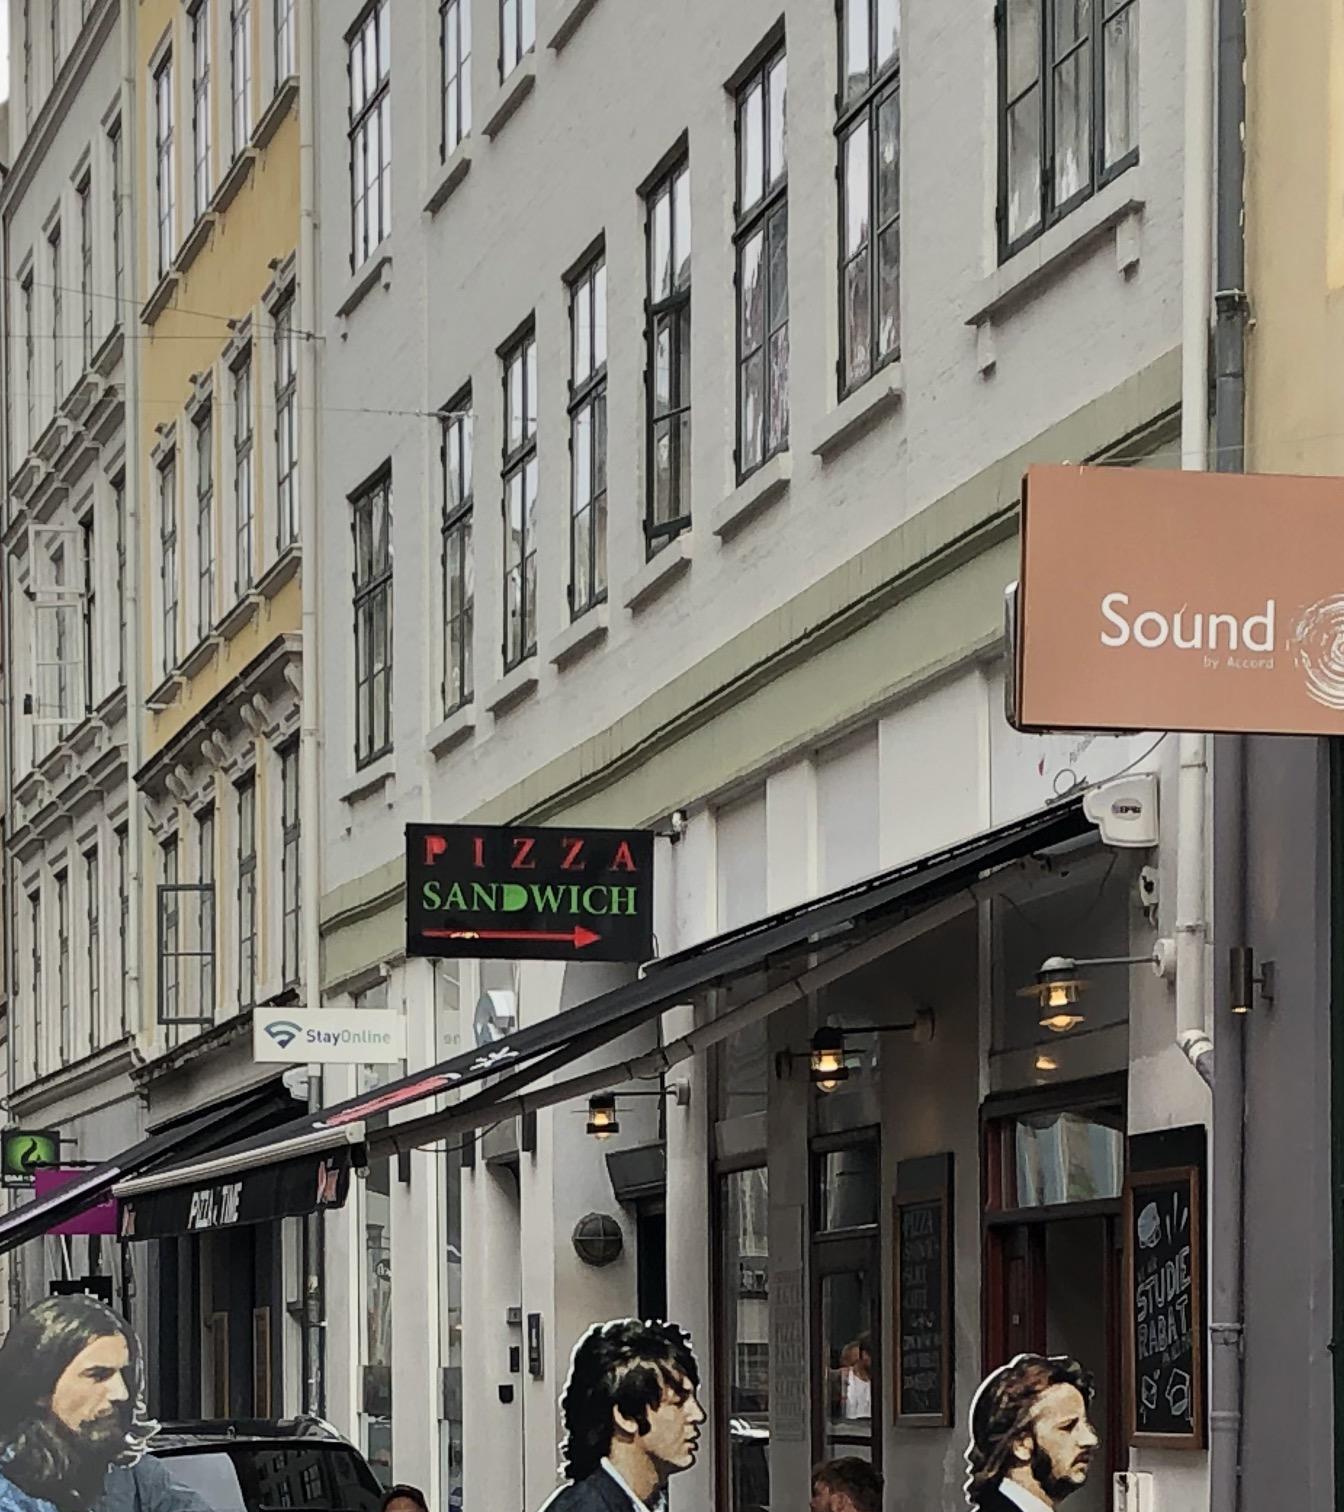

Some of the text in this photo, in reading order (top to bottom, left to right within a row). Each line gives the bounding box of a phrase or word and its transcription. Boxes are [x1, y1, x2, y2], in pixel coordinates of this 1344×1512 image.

[1100, 592, 1275, 653] Sound
[1203, 655, 1219, 669] by
[423, 835, 637, 872] PIZZA
[422, 880, 638, 916] SANDWICH
[306, 1029, 391, 1046] StayOnline
[1136, 1245, 1192, 1322] STUDIE
[1138, 1294, 1189, 1361] RABAT
